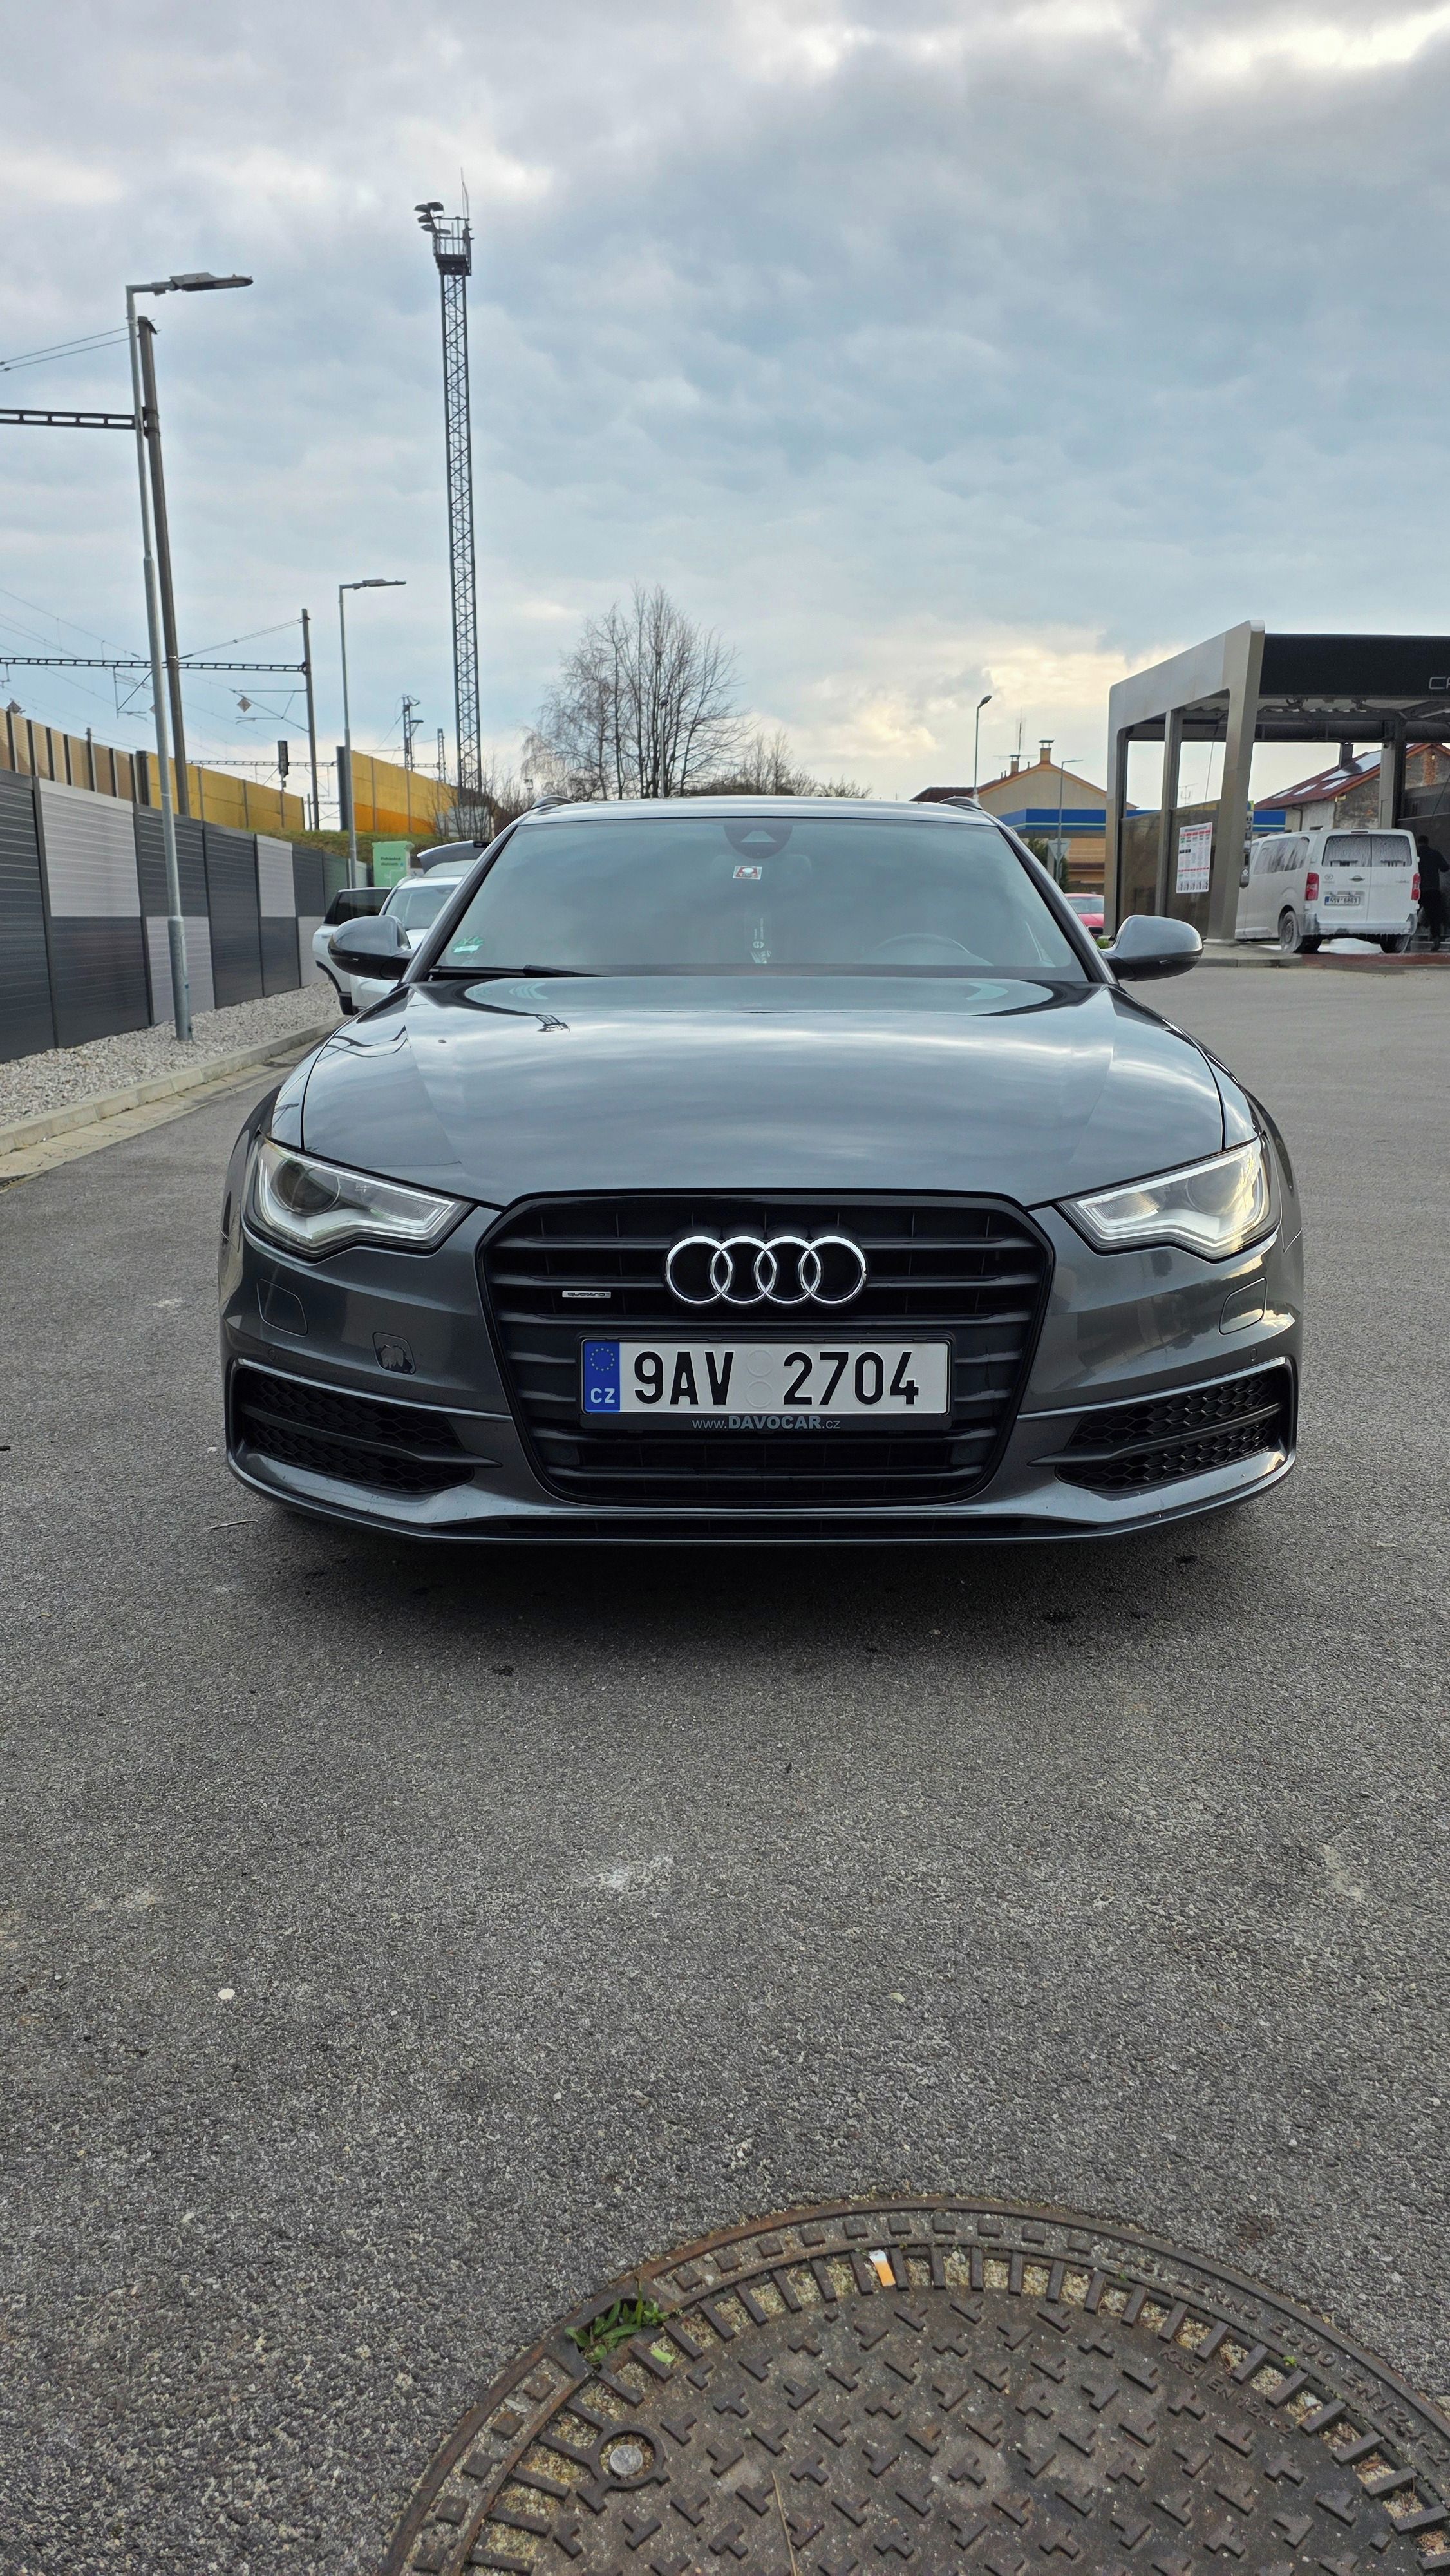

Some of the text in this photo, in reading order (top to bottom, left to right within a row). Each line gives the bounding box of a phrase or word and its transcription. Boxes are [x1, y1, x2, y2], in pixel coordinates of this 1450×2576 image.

[1429, 676, 1450, 690] C
[634, 1350, 919, 1406] 9AV 2704
[590, 1388, 616, 1404] CZ
[692, 1416, 841, 1430] www.DAVOCAR.cz
[1207, 2378, 1236, 2400] EN
